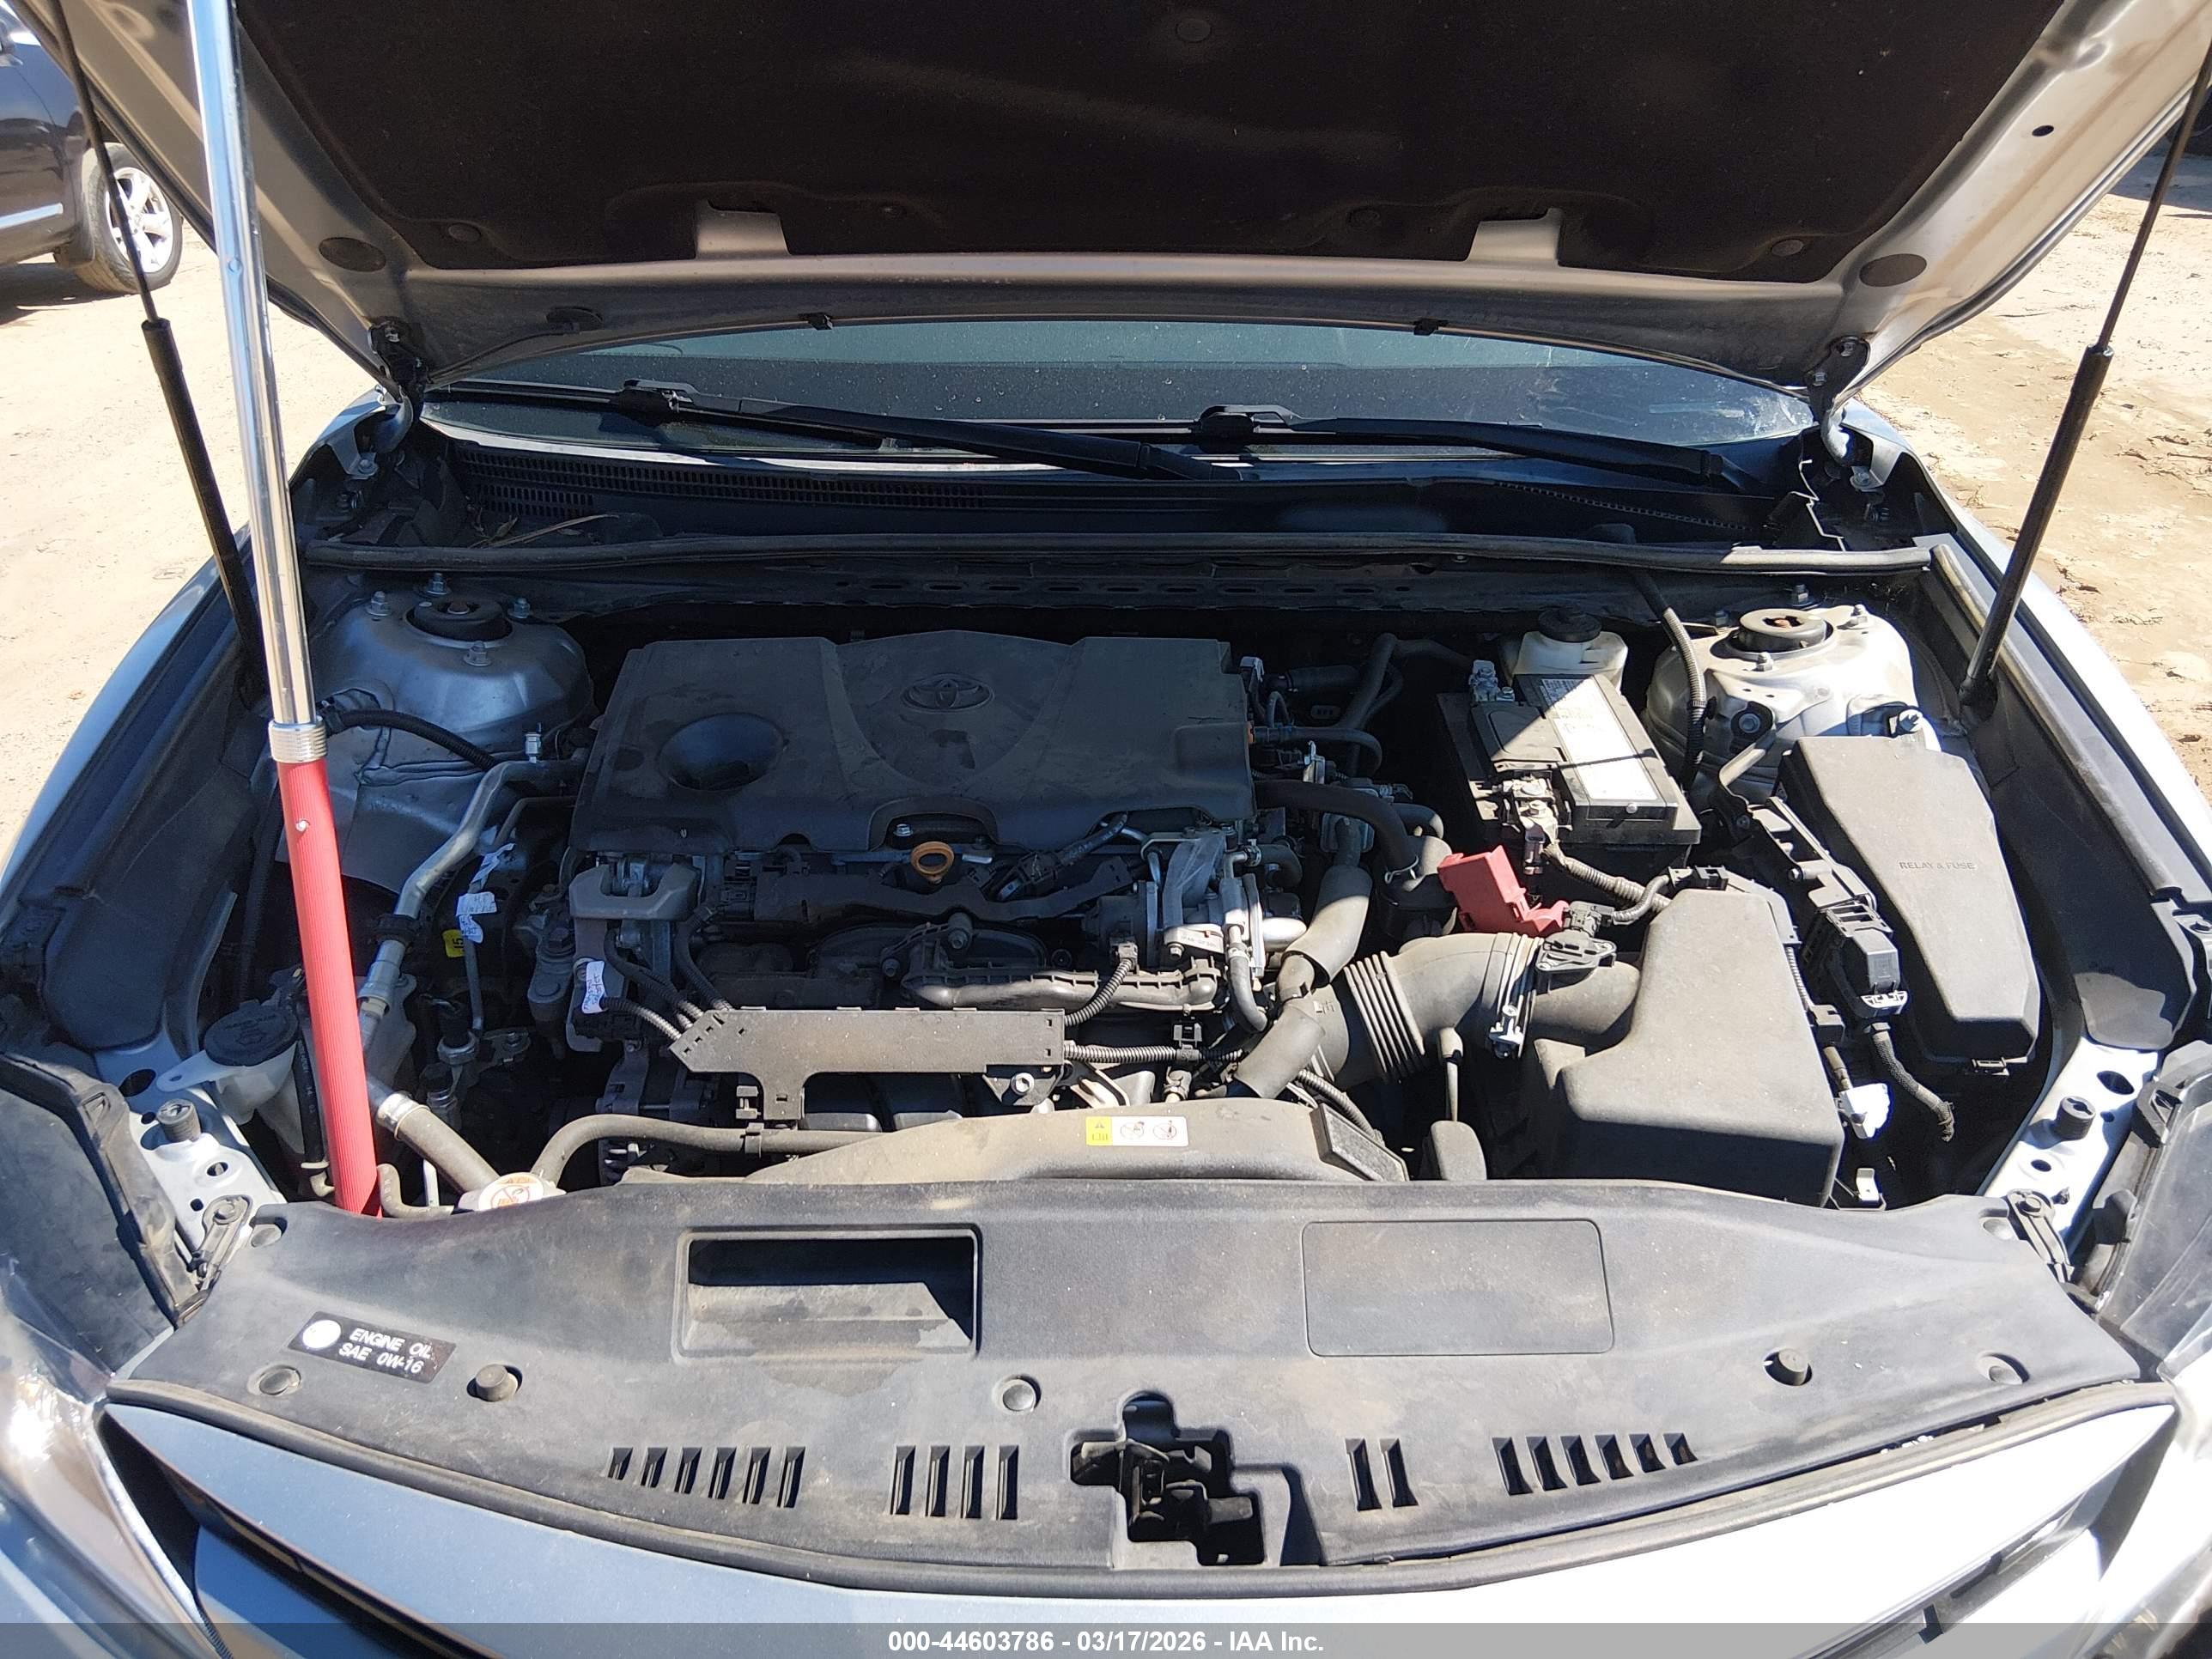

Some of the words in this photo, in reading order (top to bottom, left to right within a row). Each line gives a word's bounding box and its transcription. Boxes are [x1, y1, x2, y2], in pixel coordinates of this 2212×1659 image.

[1945, 861, 1976, 870] FUSE
[338, 1342, 373, 1361] SAE
[376, 1352, 424, 1374] 0W-16
[349, 1328, 405, 1352] ENGINE
[409, 1342, 432, 1359] OIL
